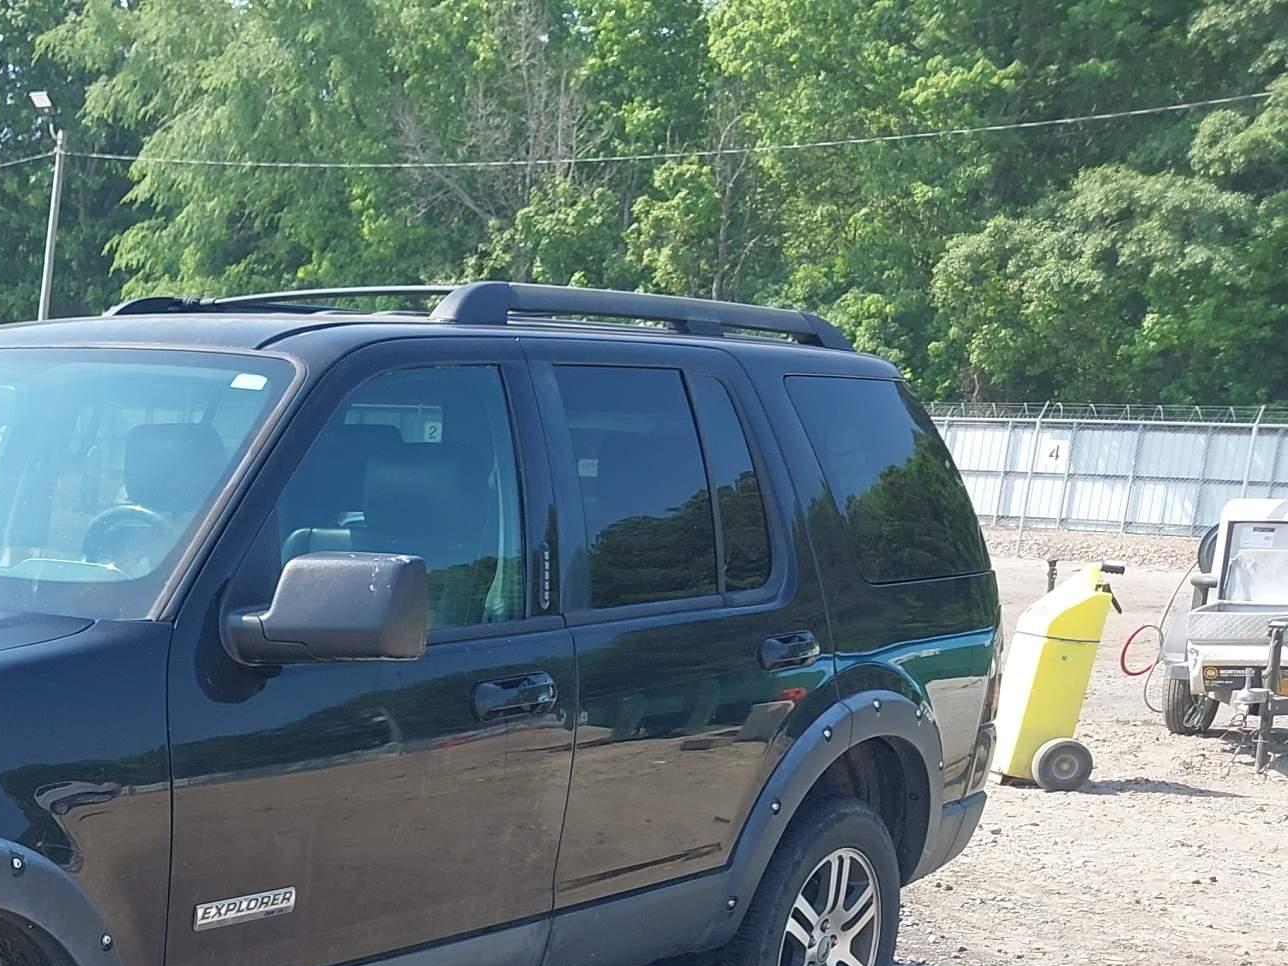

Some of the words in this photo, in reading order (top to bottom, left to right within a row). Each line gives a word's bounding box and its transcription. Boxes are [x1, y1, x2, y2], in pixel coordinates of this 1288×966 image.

[429, 425, 437, 439] 2
[1048, 444, 1060, 461] 4
[200, 891, 293, 920] EXPLORER
